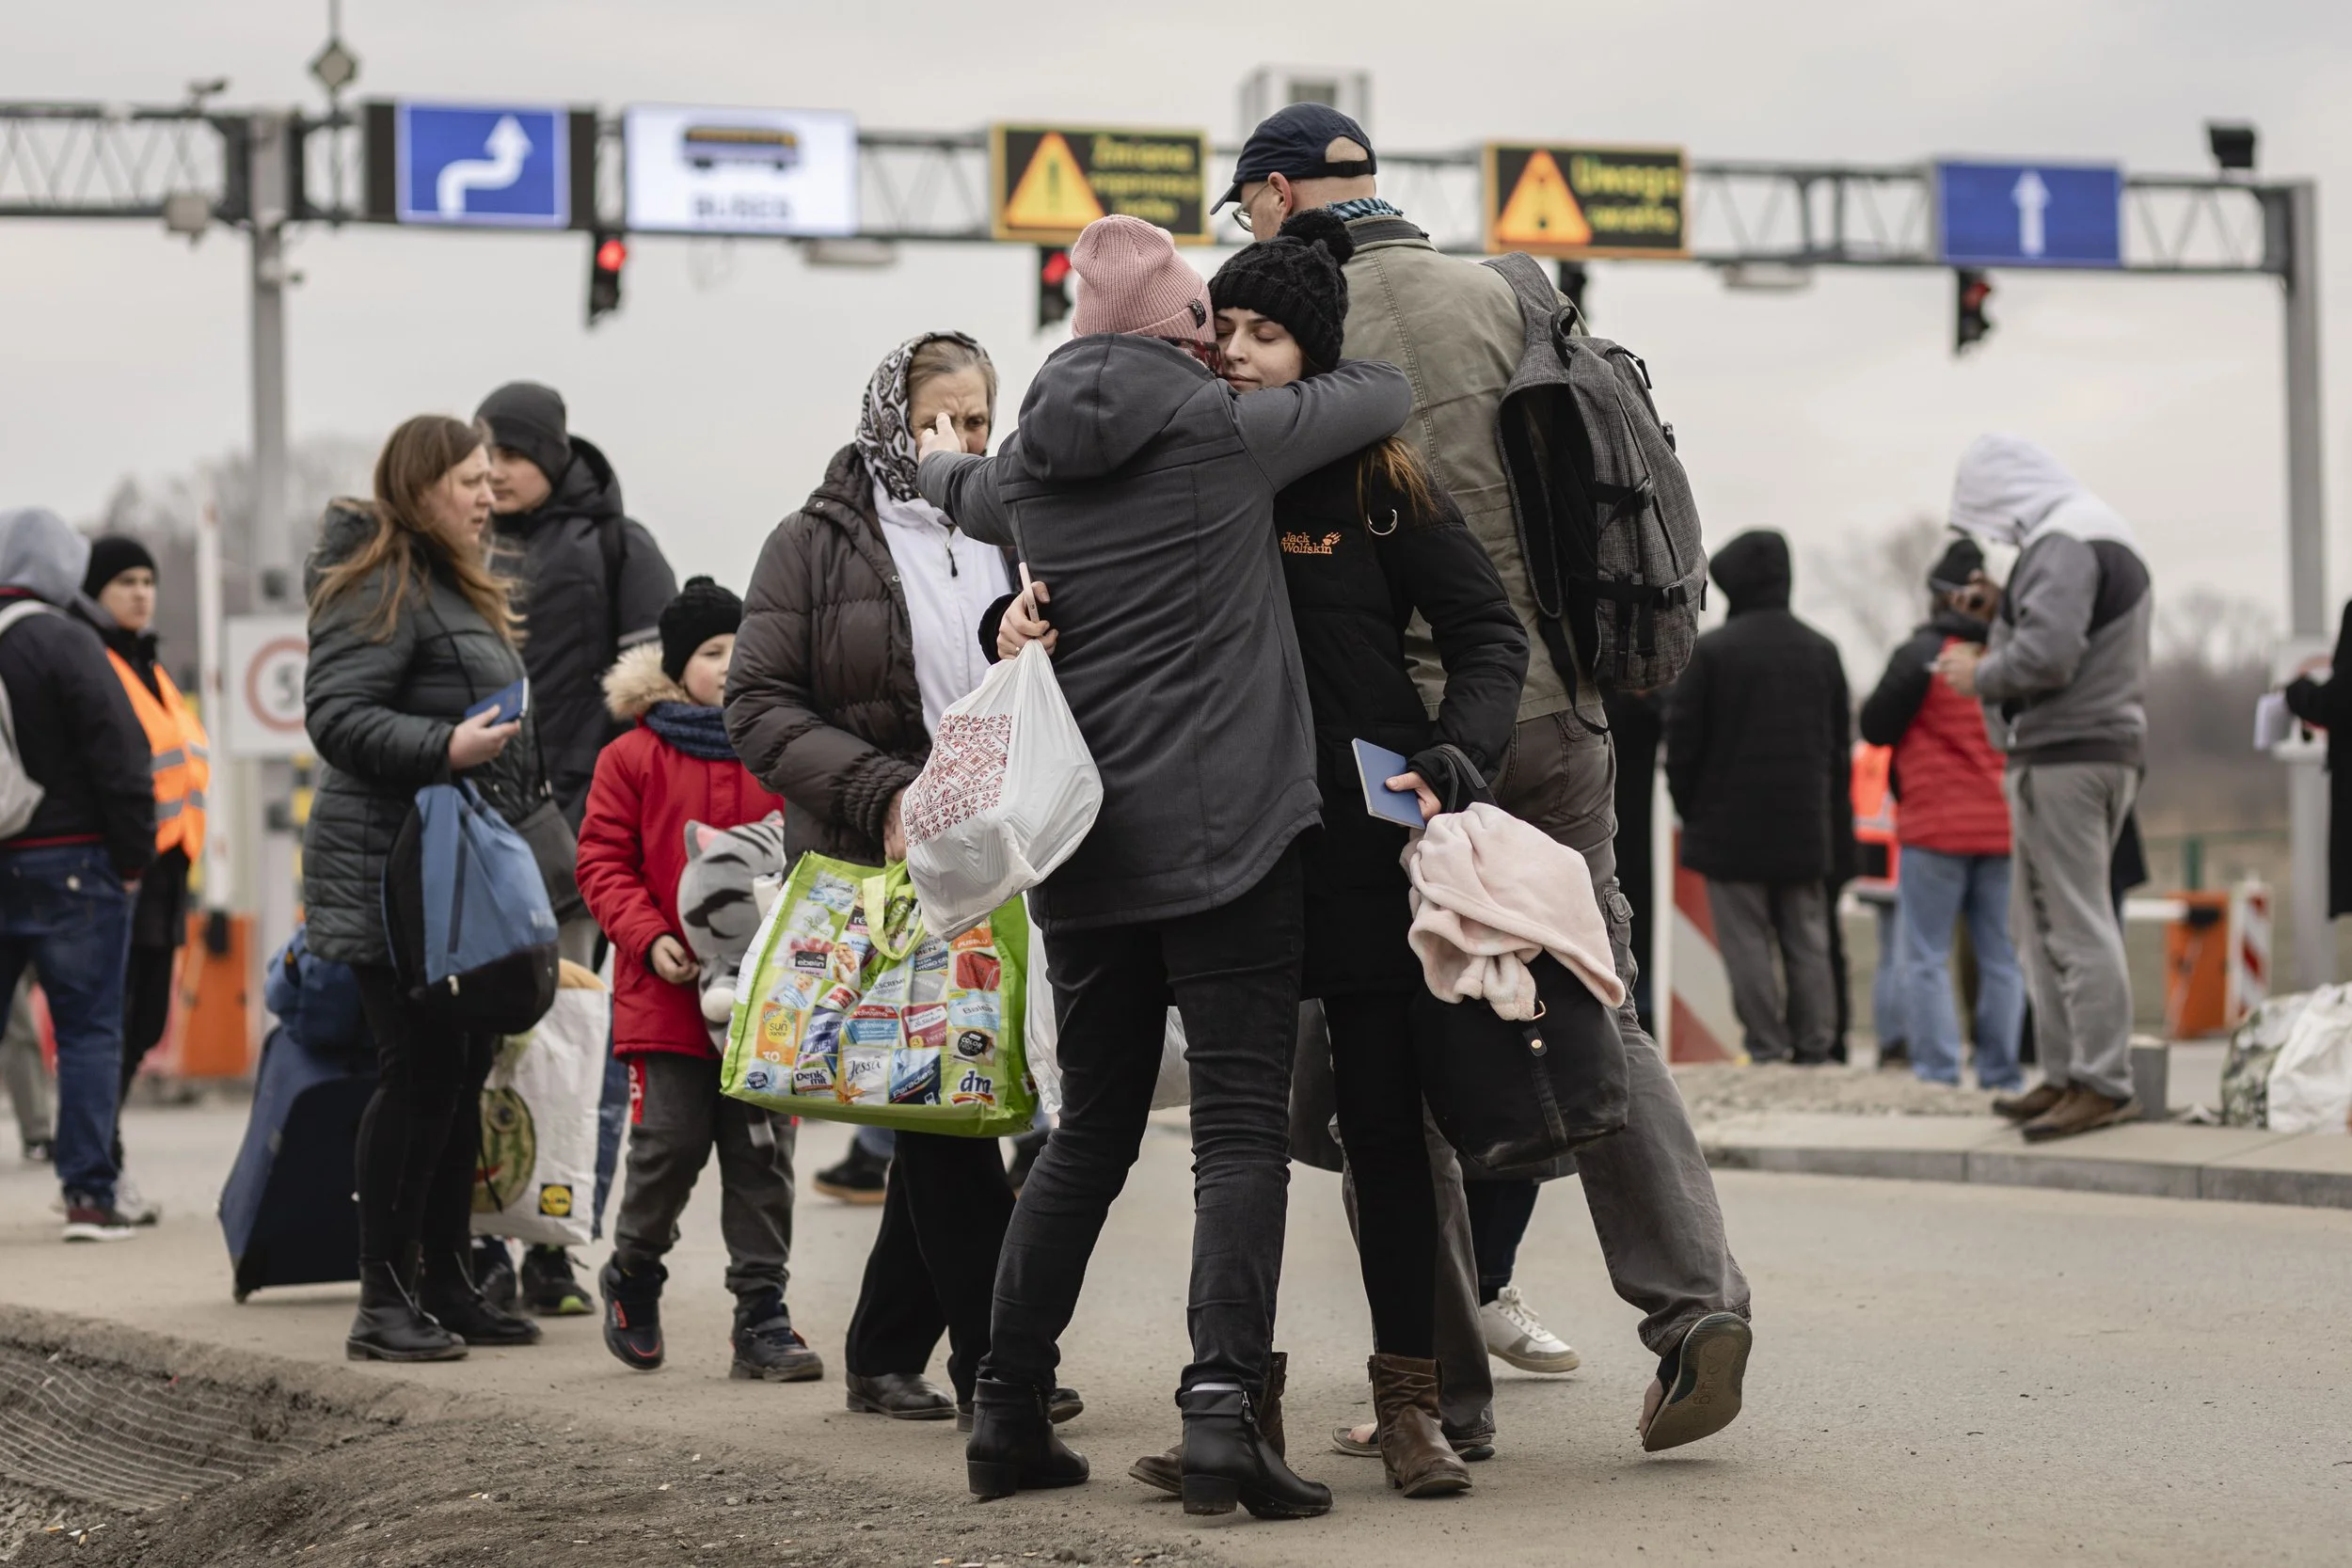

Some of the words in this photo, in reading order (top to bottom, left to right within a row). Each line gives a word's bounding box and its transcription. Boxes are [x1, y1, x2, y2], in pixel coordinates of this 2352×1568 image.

[1570, 154, 1682, 203] Uwaga
[1281, 532, 1310, 543] Jack
[1281, 543, 1332, 554] Wolfskin
[962, 1003, 993, 1014] Balea
[769, 1022, 788, 1032] sun
[796, 1070, 823, 1082] Denk
[848, 1060, 881, 1082] Jessa
[893, 1069, 934, 1099] Paradies
[960, 1070, 992, 1093] dm
